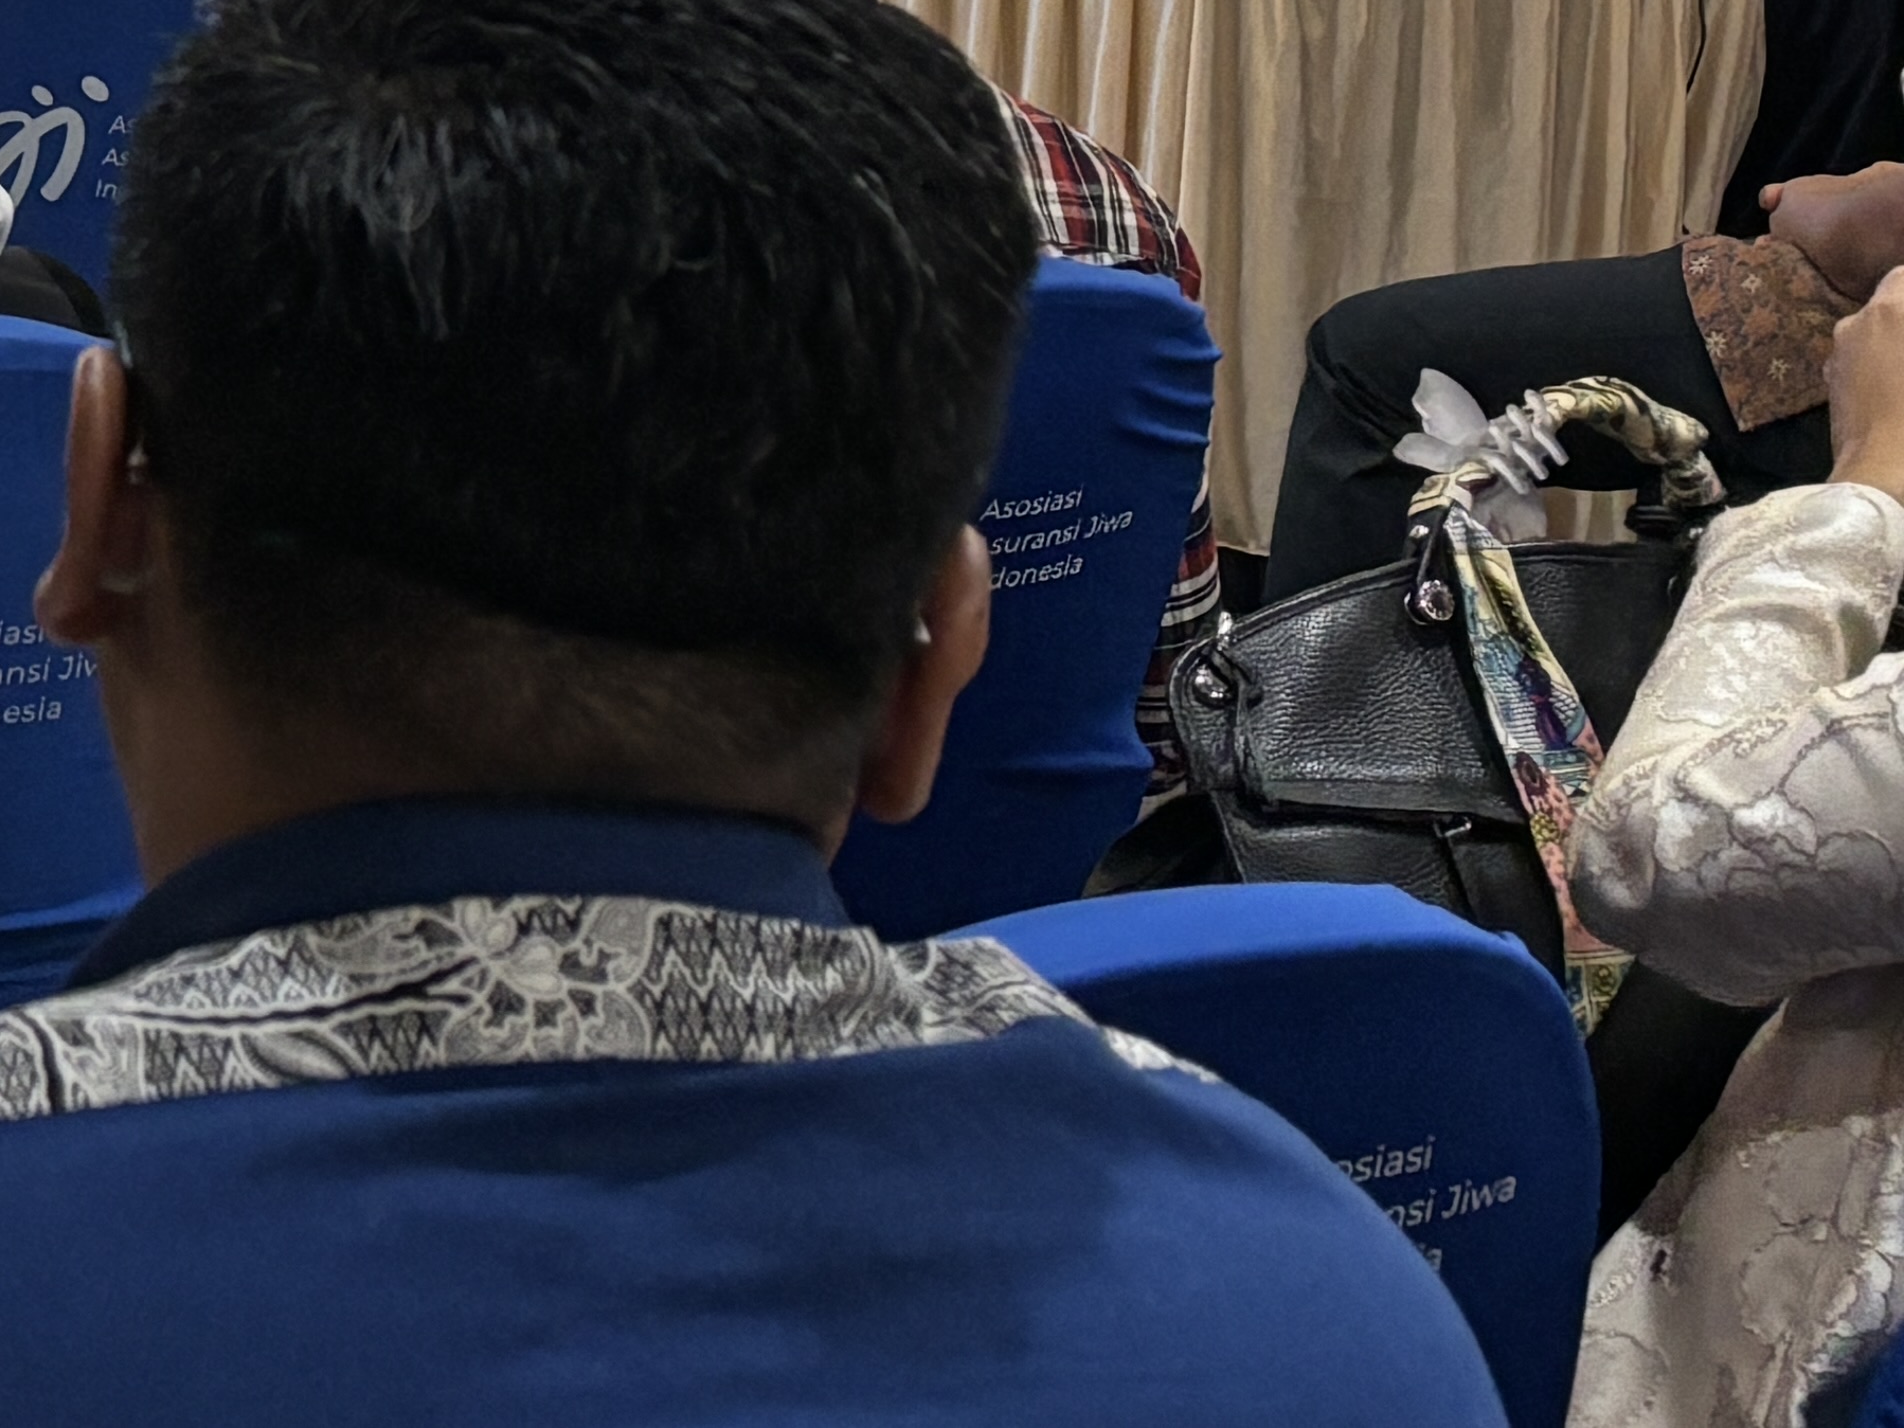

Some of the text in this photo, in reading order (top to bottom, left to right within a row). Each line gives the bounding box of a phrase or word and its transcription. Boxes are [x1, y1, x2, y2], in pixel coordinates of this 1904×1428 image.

[979, 484, 1084, 522] Asosiasi
[991, 510, 1133, 555] suransi Jiwa
[991, 554, 1083, 590] donesia
[1442, 1175, 1517, 1219] Jiwa
